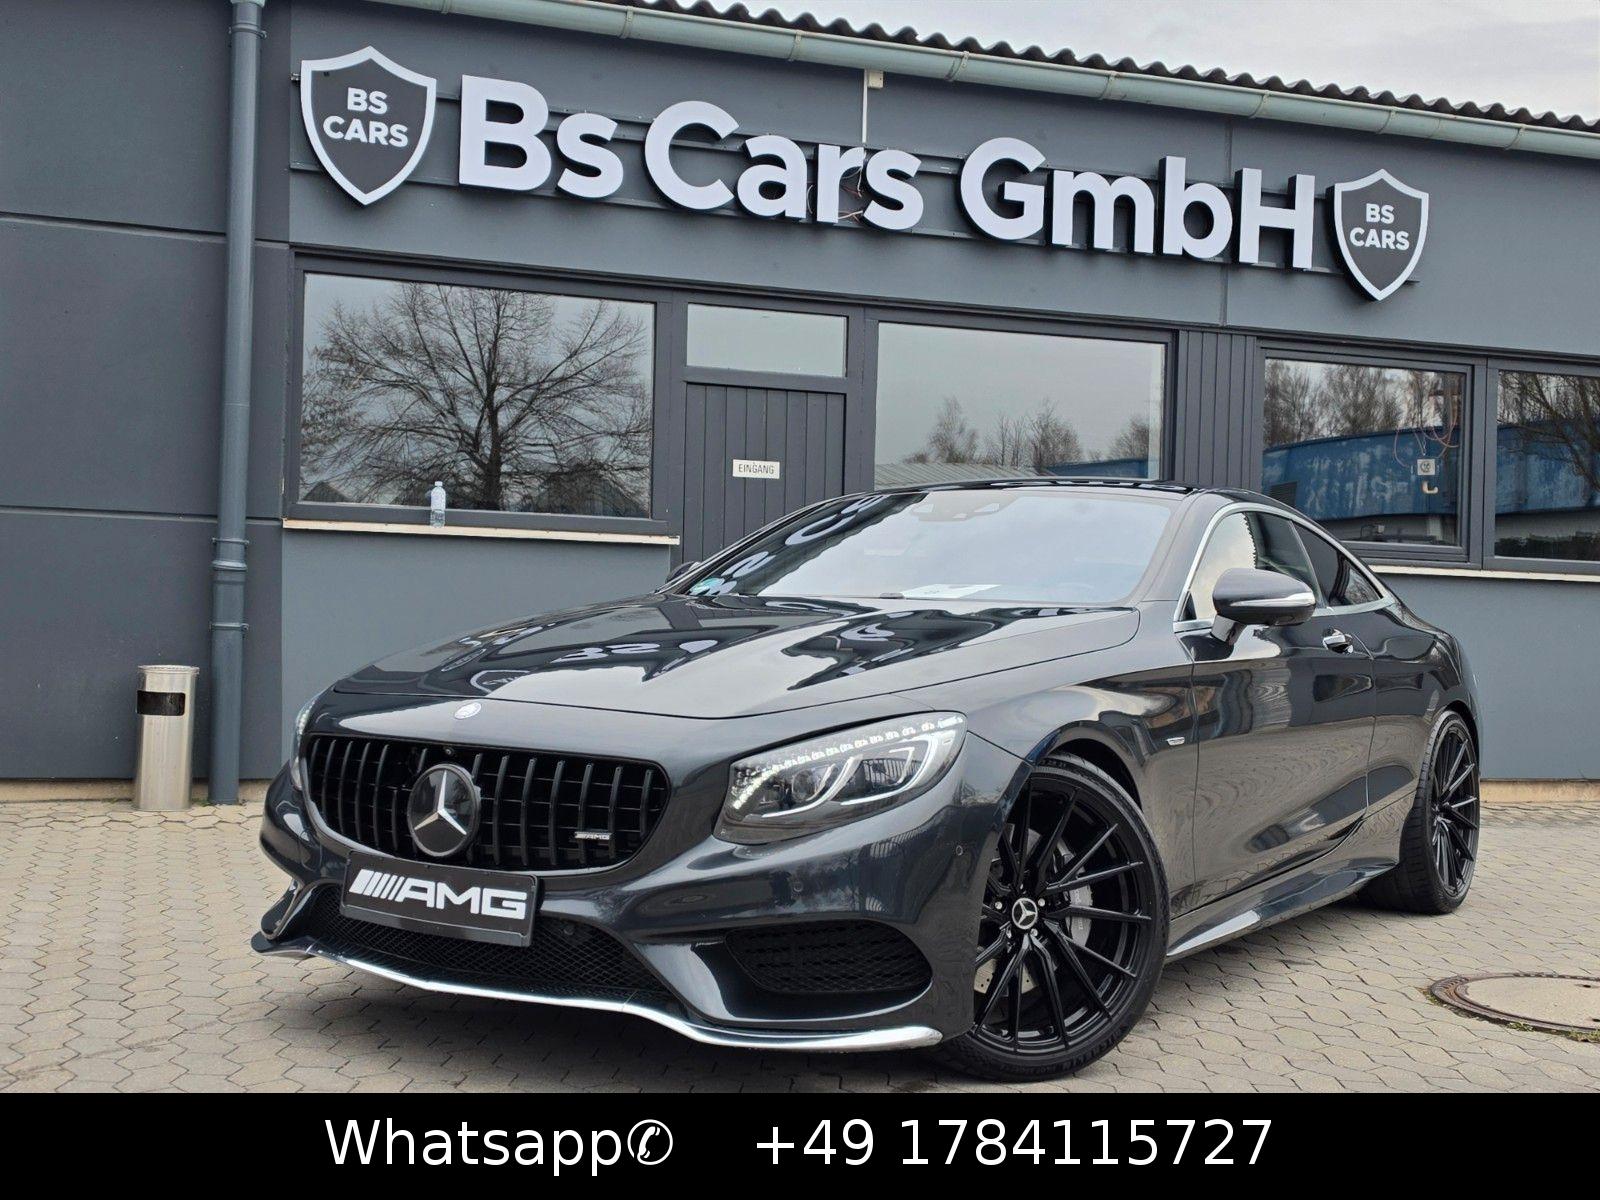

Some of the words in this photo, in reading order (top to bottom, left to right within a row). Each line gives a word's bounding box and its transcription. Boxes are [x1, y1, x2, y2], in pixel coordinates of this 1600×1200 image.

[347, 87, 388, 115] BS
[322, 115, 409, 148] CARS
[458, 74, 625, 199] Bs
[643, 100, 925, 231] Cars
[959, 136, 1316, 270] GmbH
[1365, 202, 1395, 225] BS
[1349, 226, 1411, 251] CARS
[738, 463, 775, 475] EINGANG
[393, 876, 528, 920] AMG
